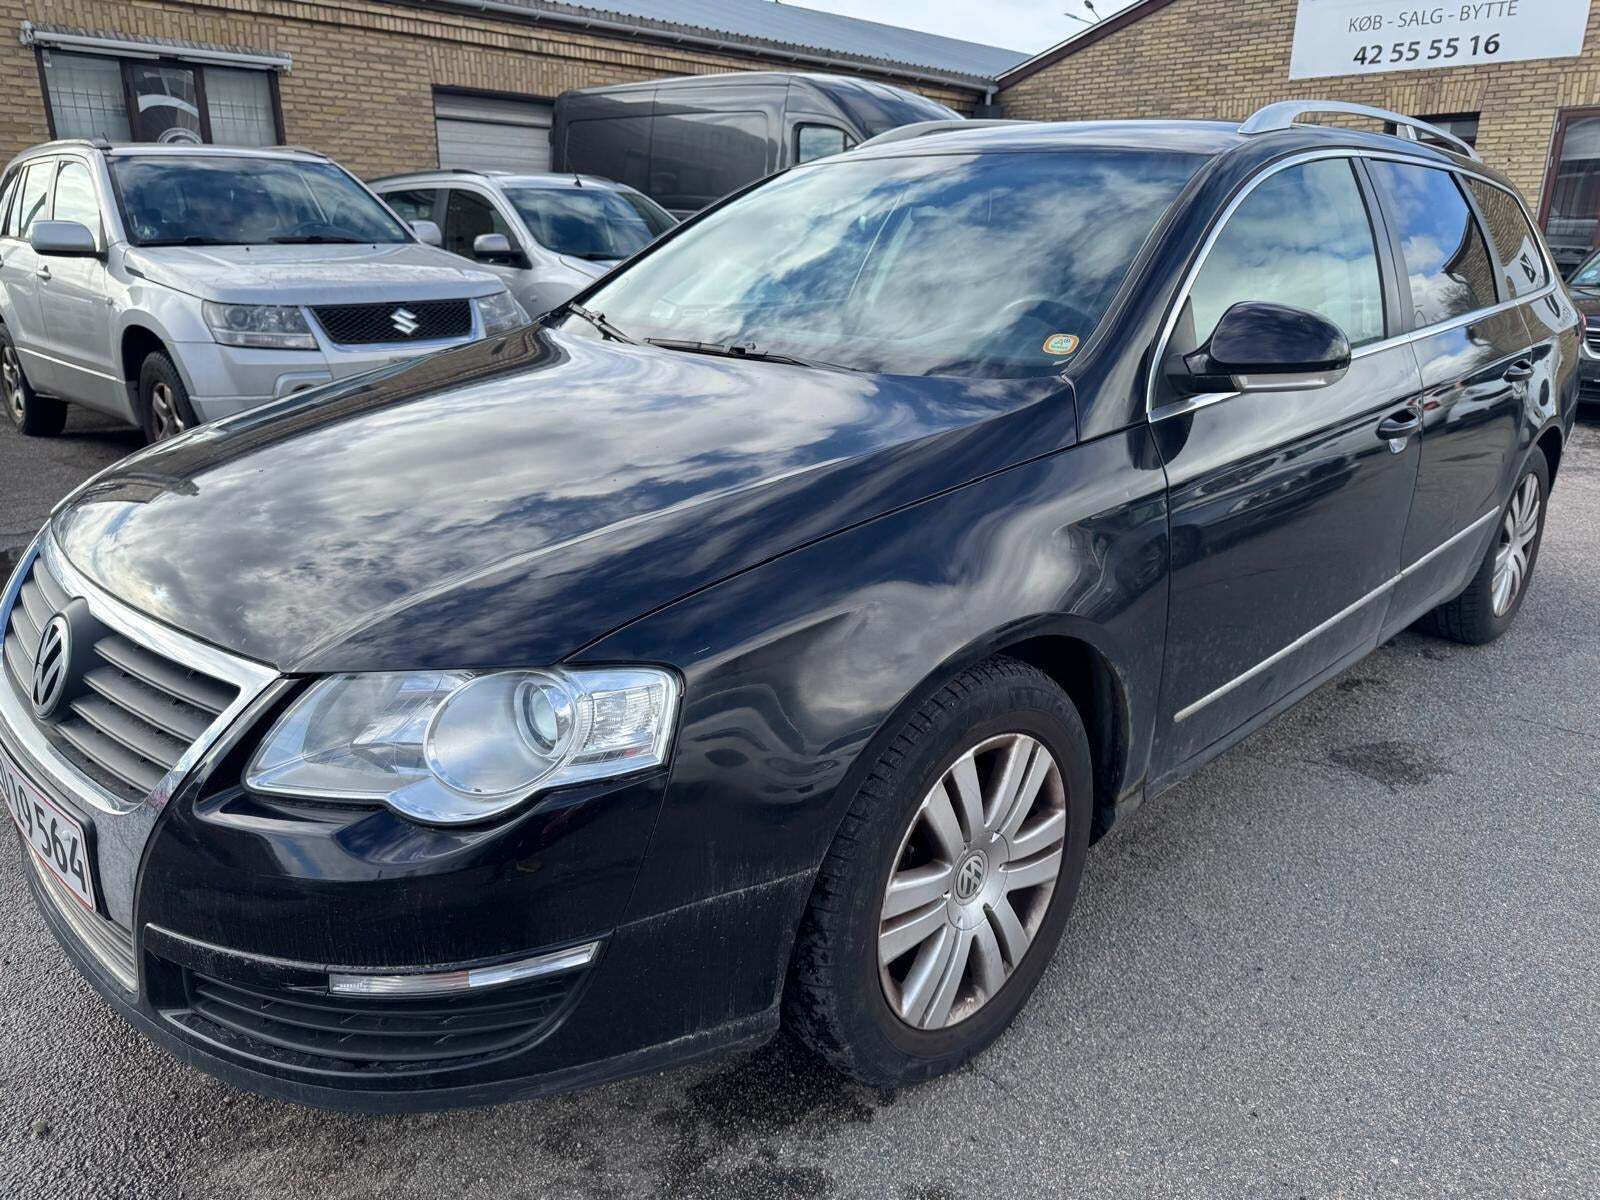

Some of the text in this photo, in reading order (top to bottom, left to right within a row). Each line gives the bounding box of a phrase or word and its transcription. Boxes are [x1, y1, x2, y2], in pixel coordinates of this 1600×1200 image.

[1348, 15, 1383, 33] KØB
[1397, 8, 1444, 28] SALG
[1460, 0, 1519, 21] BYTTE
[1353, 33, 1500, 65] 42 55 55 16
[33, 800, 87, 894] 564
